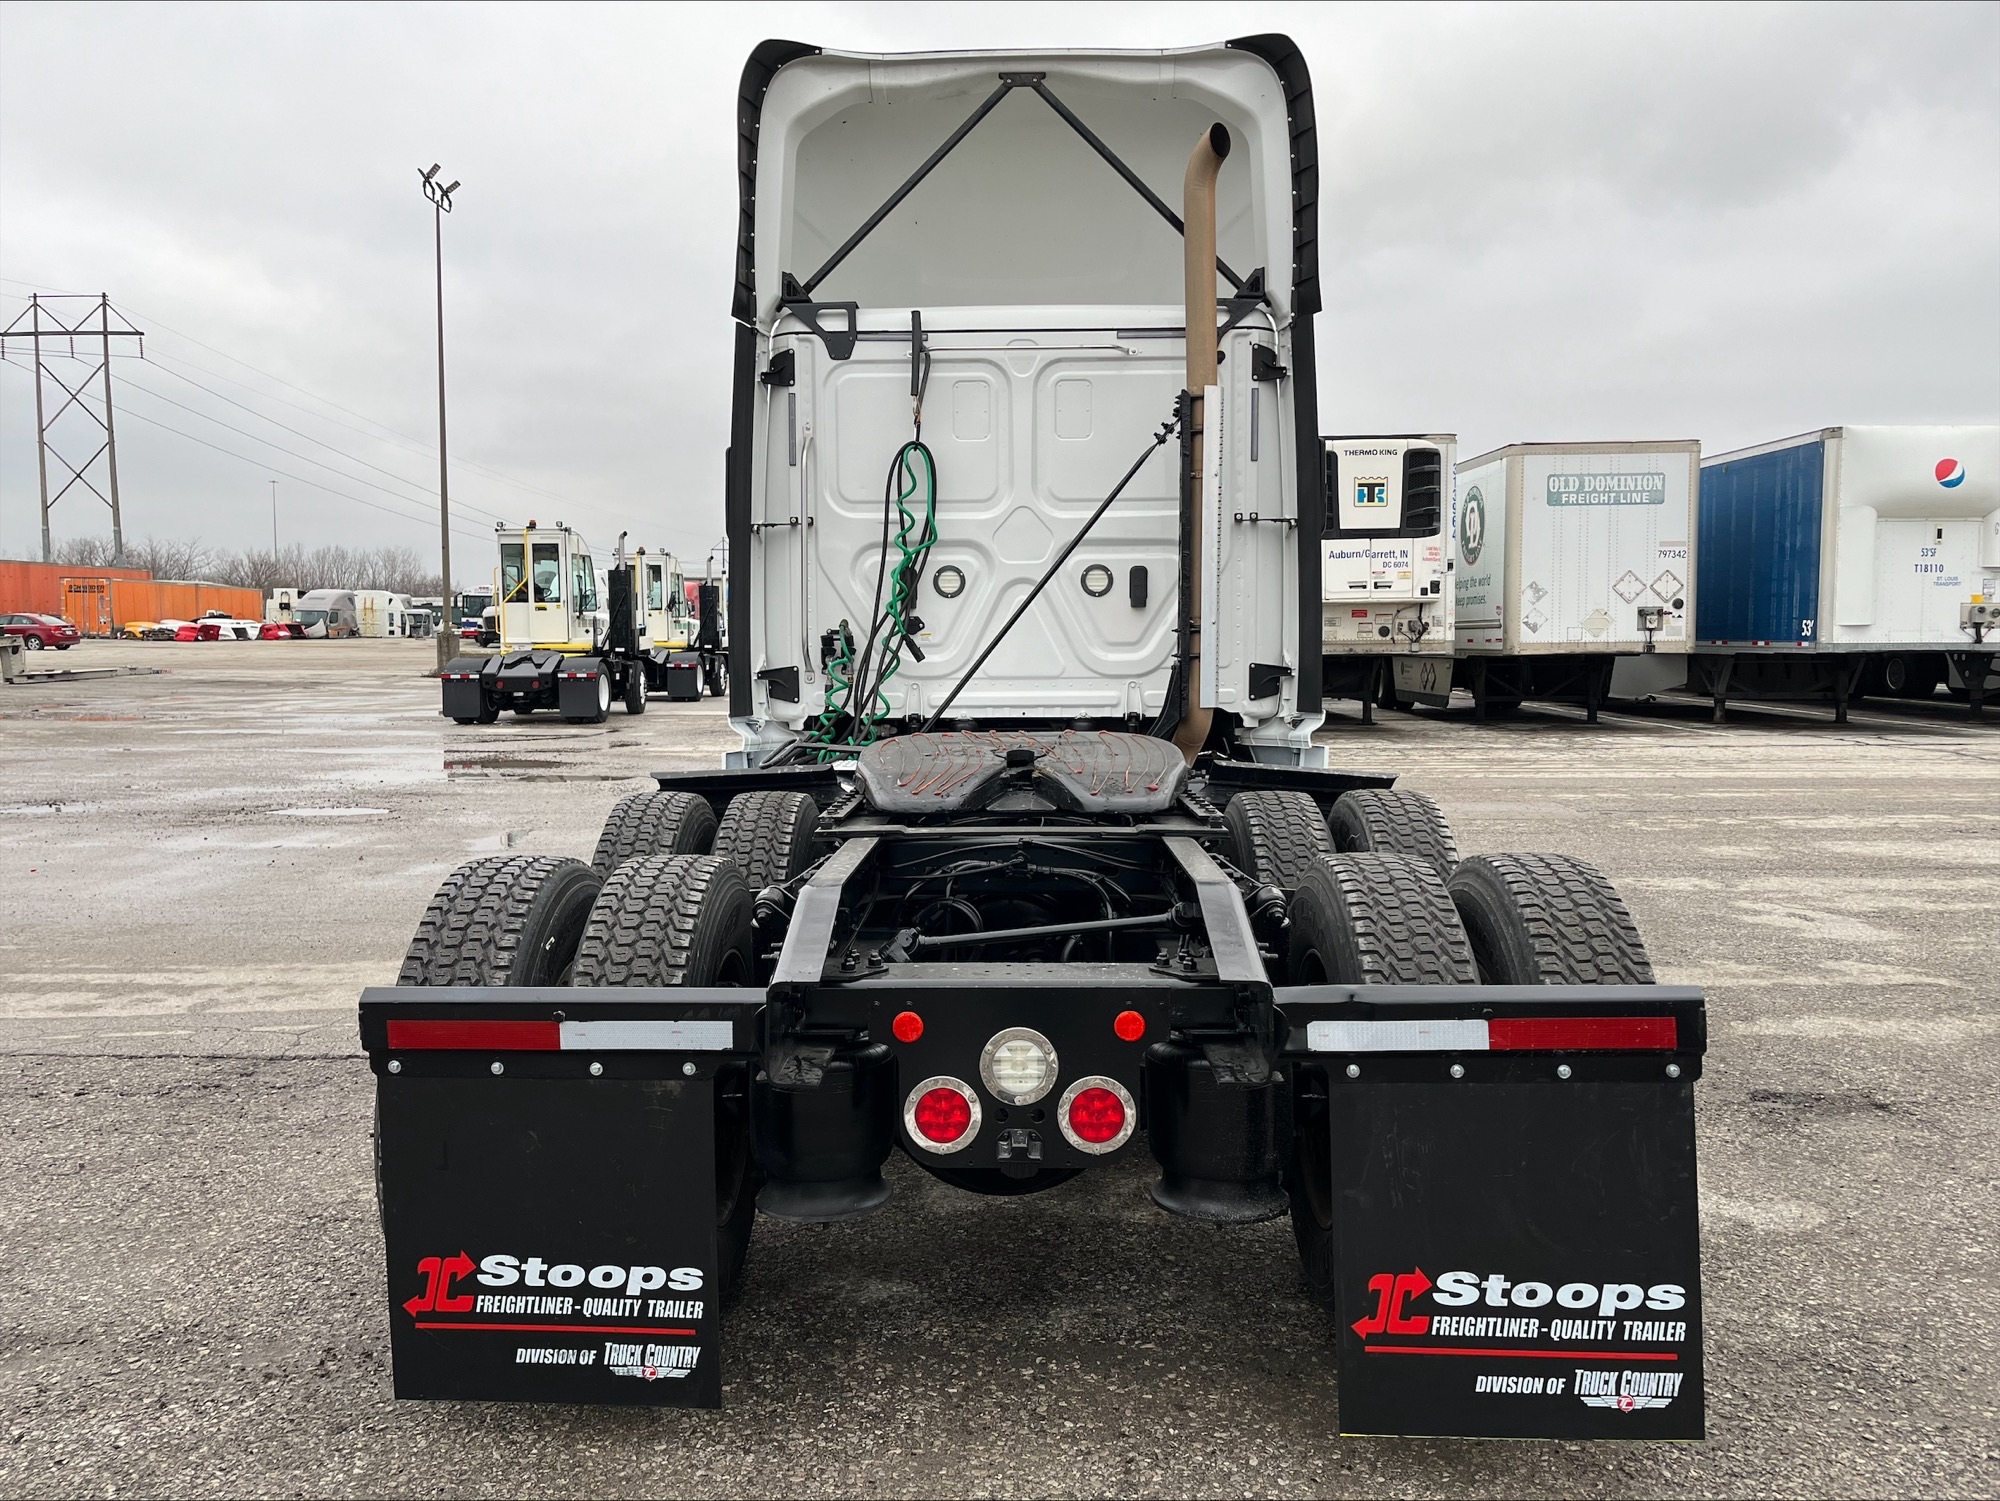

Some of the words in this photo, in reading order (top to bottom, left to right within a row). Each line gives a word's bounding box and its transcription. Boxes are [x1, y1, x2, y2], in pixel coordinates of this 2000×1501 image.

[1548, 476, 1580, 492] OLD
[1583, 475, 1664, 492] DOMINION
[1561, 492, 1617, 504] FREIGHT
[1620, 492, 1651, 504] LINE
[1400, 549, 1408, 559] IN
[1658, 549, 1687, 559] 797342
[1382, 561, 1391, 569] DC
[1393, 561, 1409, 569] 6074
[1914, 563, 1944, 573] T18110
[476, 1254, 704, 1296] Stoops
[1432, 1271, 1686, 1317] Stoops
[647, 1299, 704, 1319] TRAILER
[1623, 1320, 1686, 1342] TRAILER
[515, 1348, 576, 1365] DIVISION
[579, 1349, 597, 1366] OF
[603, 1342, 644, 1367] TRUCK
[644, 1343, 701, 1368] COUNTRY
[1475, 1375, 1545, 1394] DIVISION
[1546, 1377, 1566, 1394] OF
[1574, 1369, 1619, 1396] TRUCK
[1620, 1370, 1684, 1397] COUNTRY
